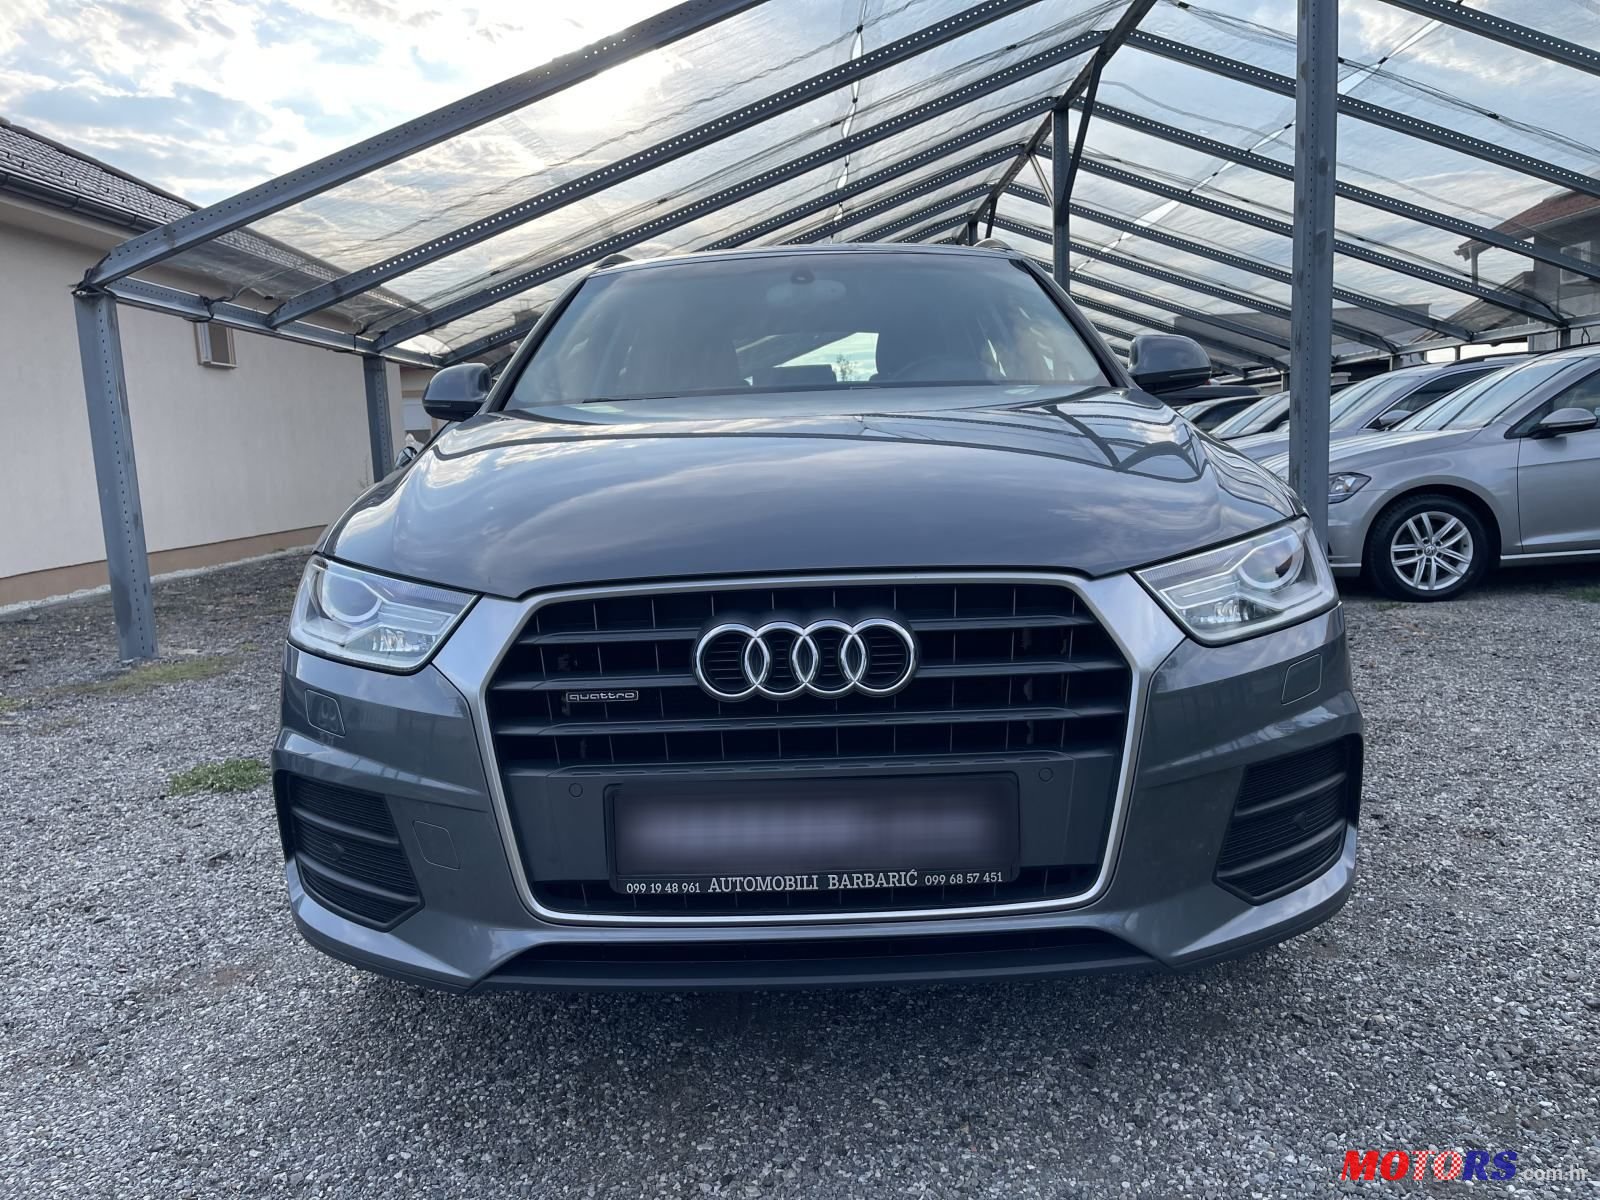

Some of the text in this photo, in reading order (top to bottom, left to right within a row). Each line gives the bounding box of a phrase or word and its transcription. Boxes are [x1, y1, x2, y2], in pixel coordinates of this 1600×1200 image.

[569, 692, 635, 701] quattro
[626, 868, 1002, 893] 099 19 48 961 AUTOMOBILI BARBARIĆ 099 68 57 451
